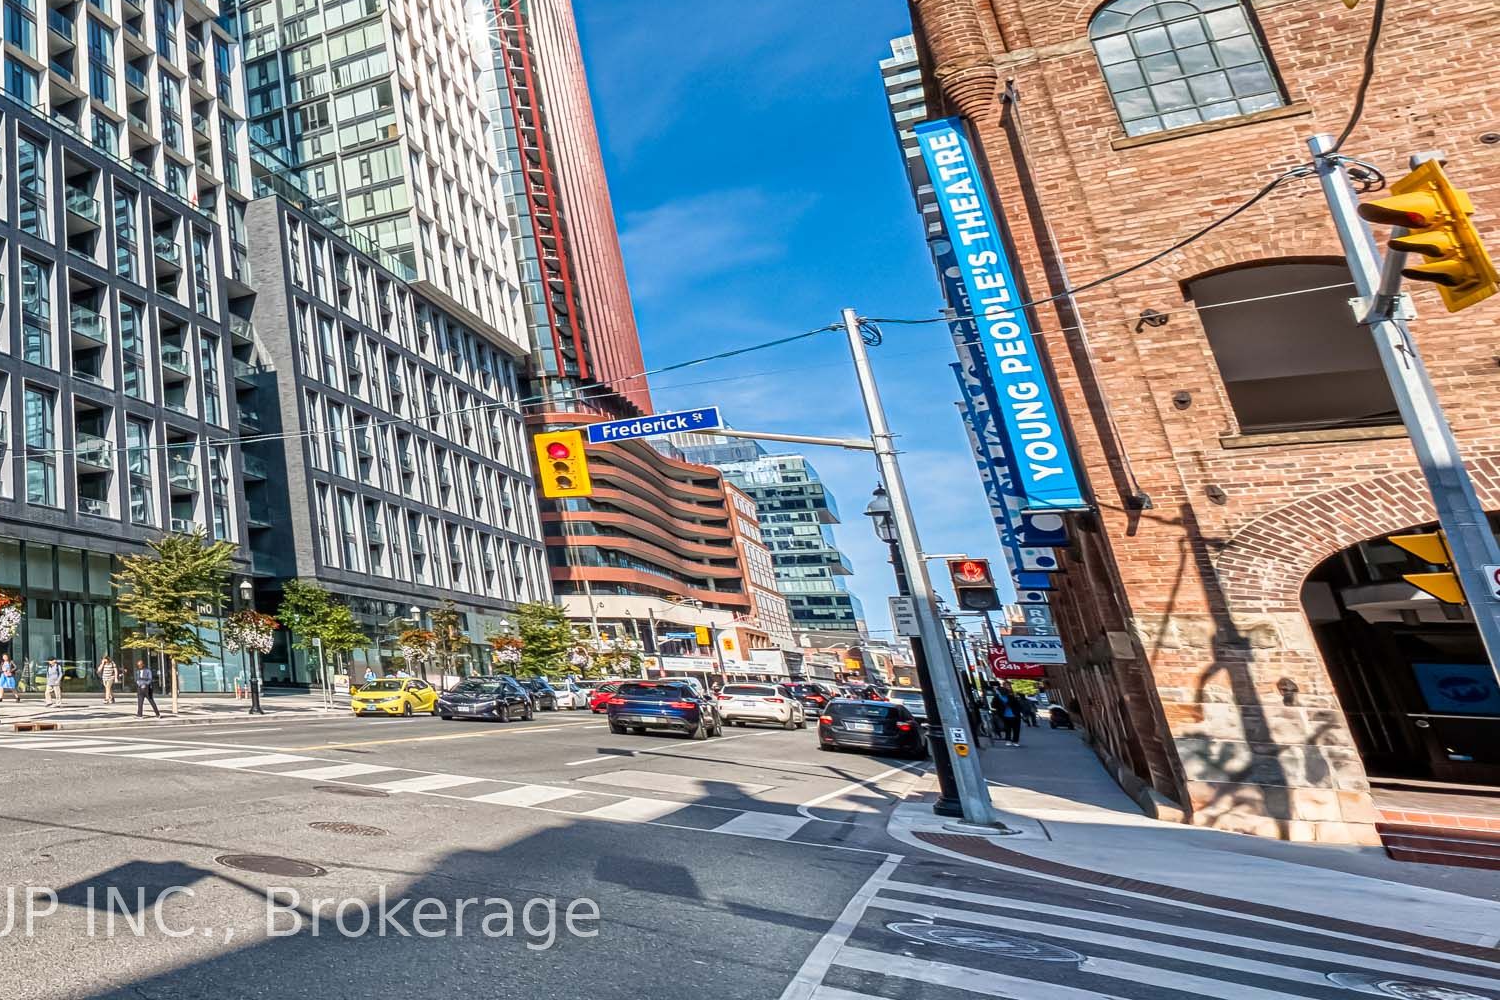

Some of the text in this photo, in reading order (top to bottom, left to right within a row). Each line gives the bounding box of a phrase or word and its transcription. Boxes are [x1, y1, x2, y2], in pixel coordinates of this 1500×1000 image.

[928, 130, 990, 248] THEATRE
[967, 251, 1033, 375] PEOPLE'S
[602, 412, 703, 438] Frederick St
[1008, 380, 1065, 482] YOUNG
